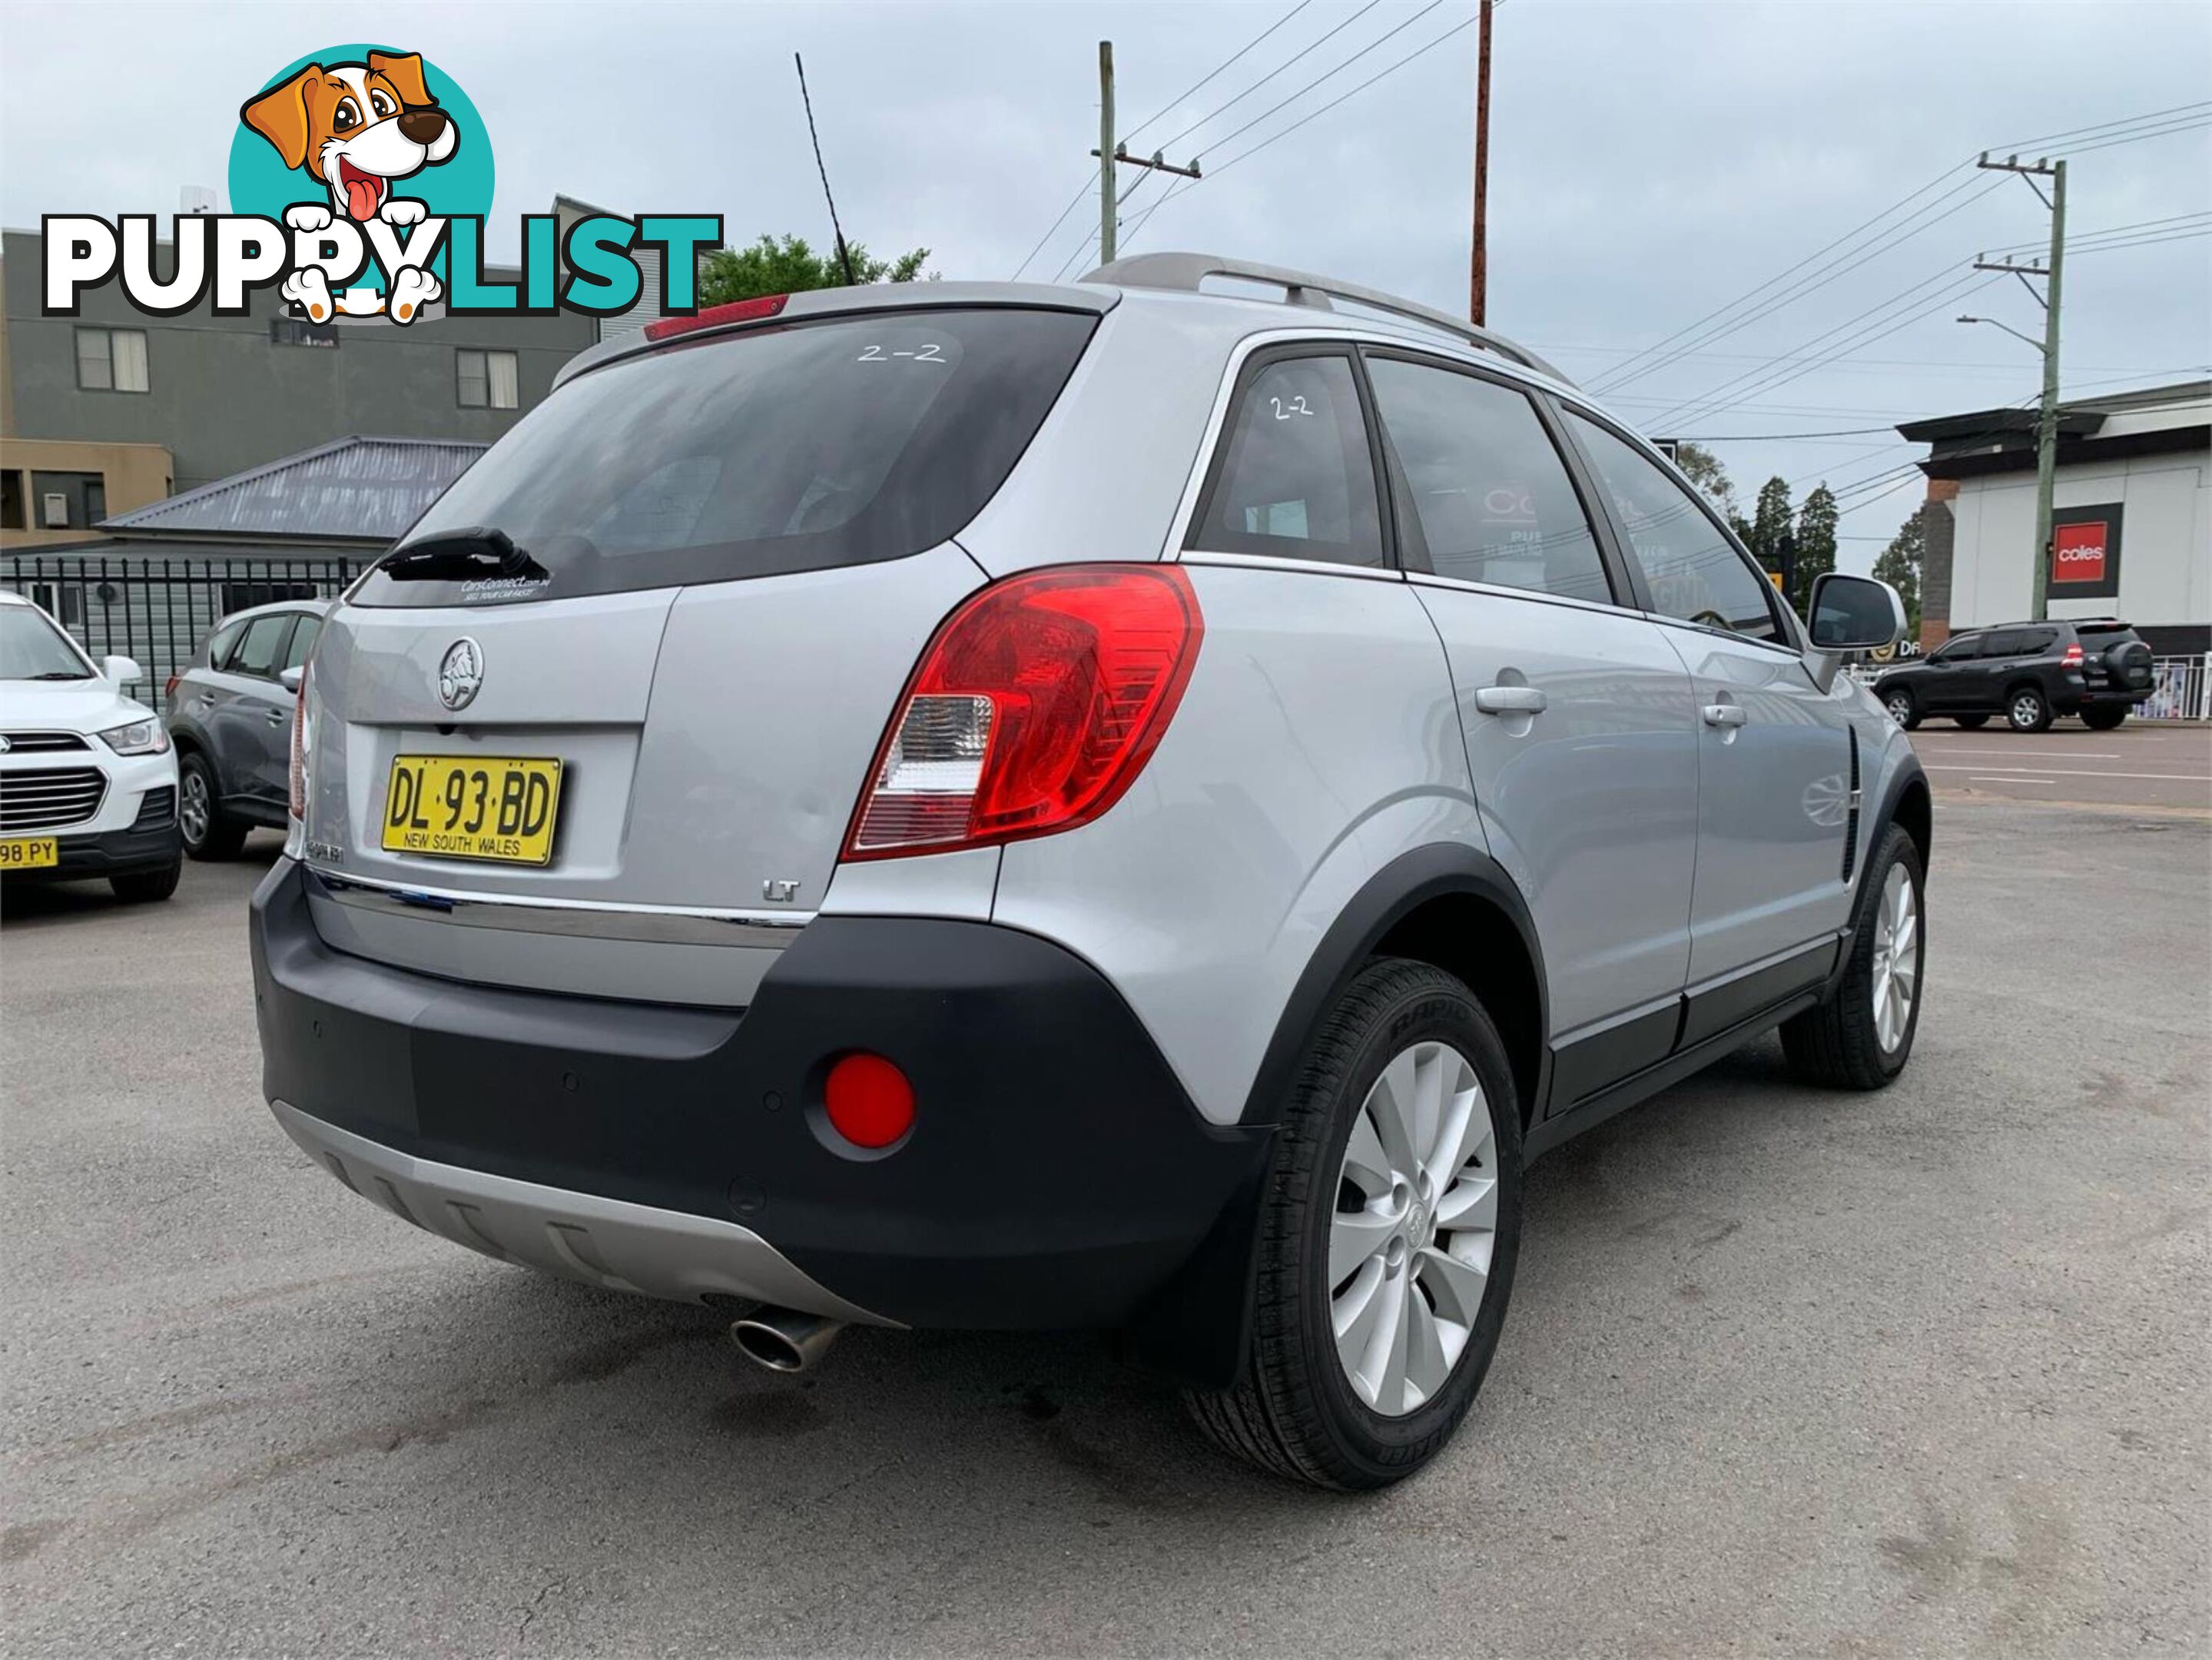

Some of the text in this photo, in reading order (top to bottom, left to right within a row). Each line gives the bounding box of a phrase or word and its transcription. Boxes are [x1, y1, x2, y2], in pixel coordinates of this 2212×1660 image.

[1271, 396, 1314, 420] 2-2
[2059, 545, 2103, 562] coles
[404, 834, 521, 856] NEW SOUTH WALES
[763, 880, 801, 902] LT
